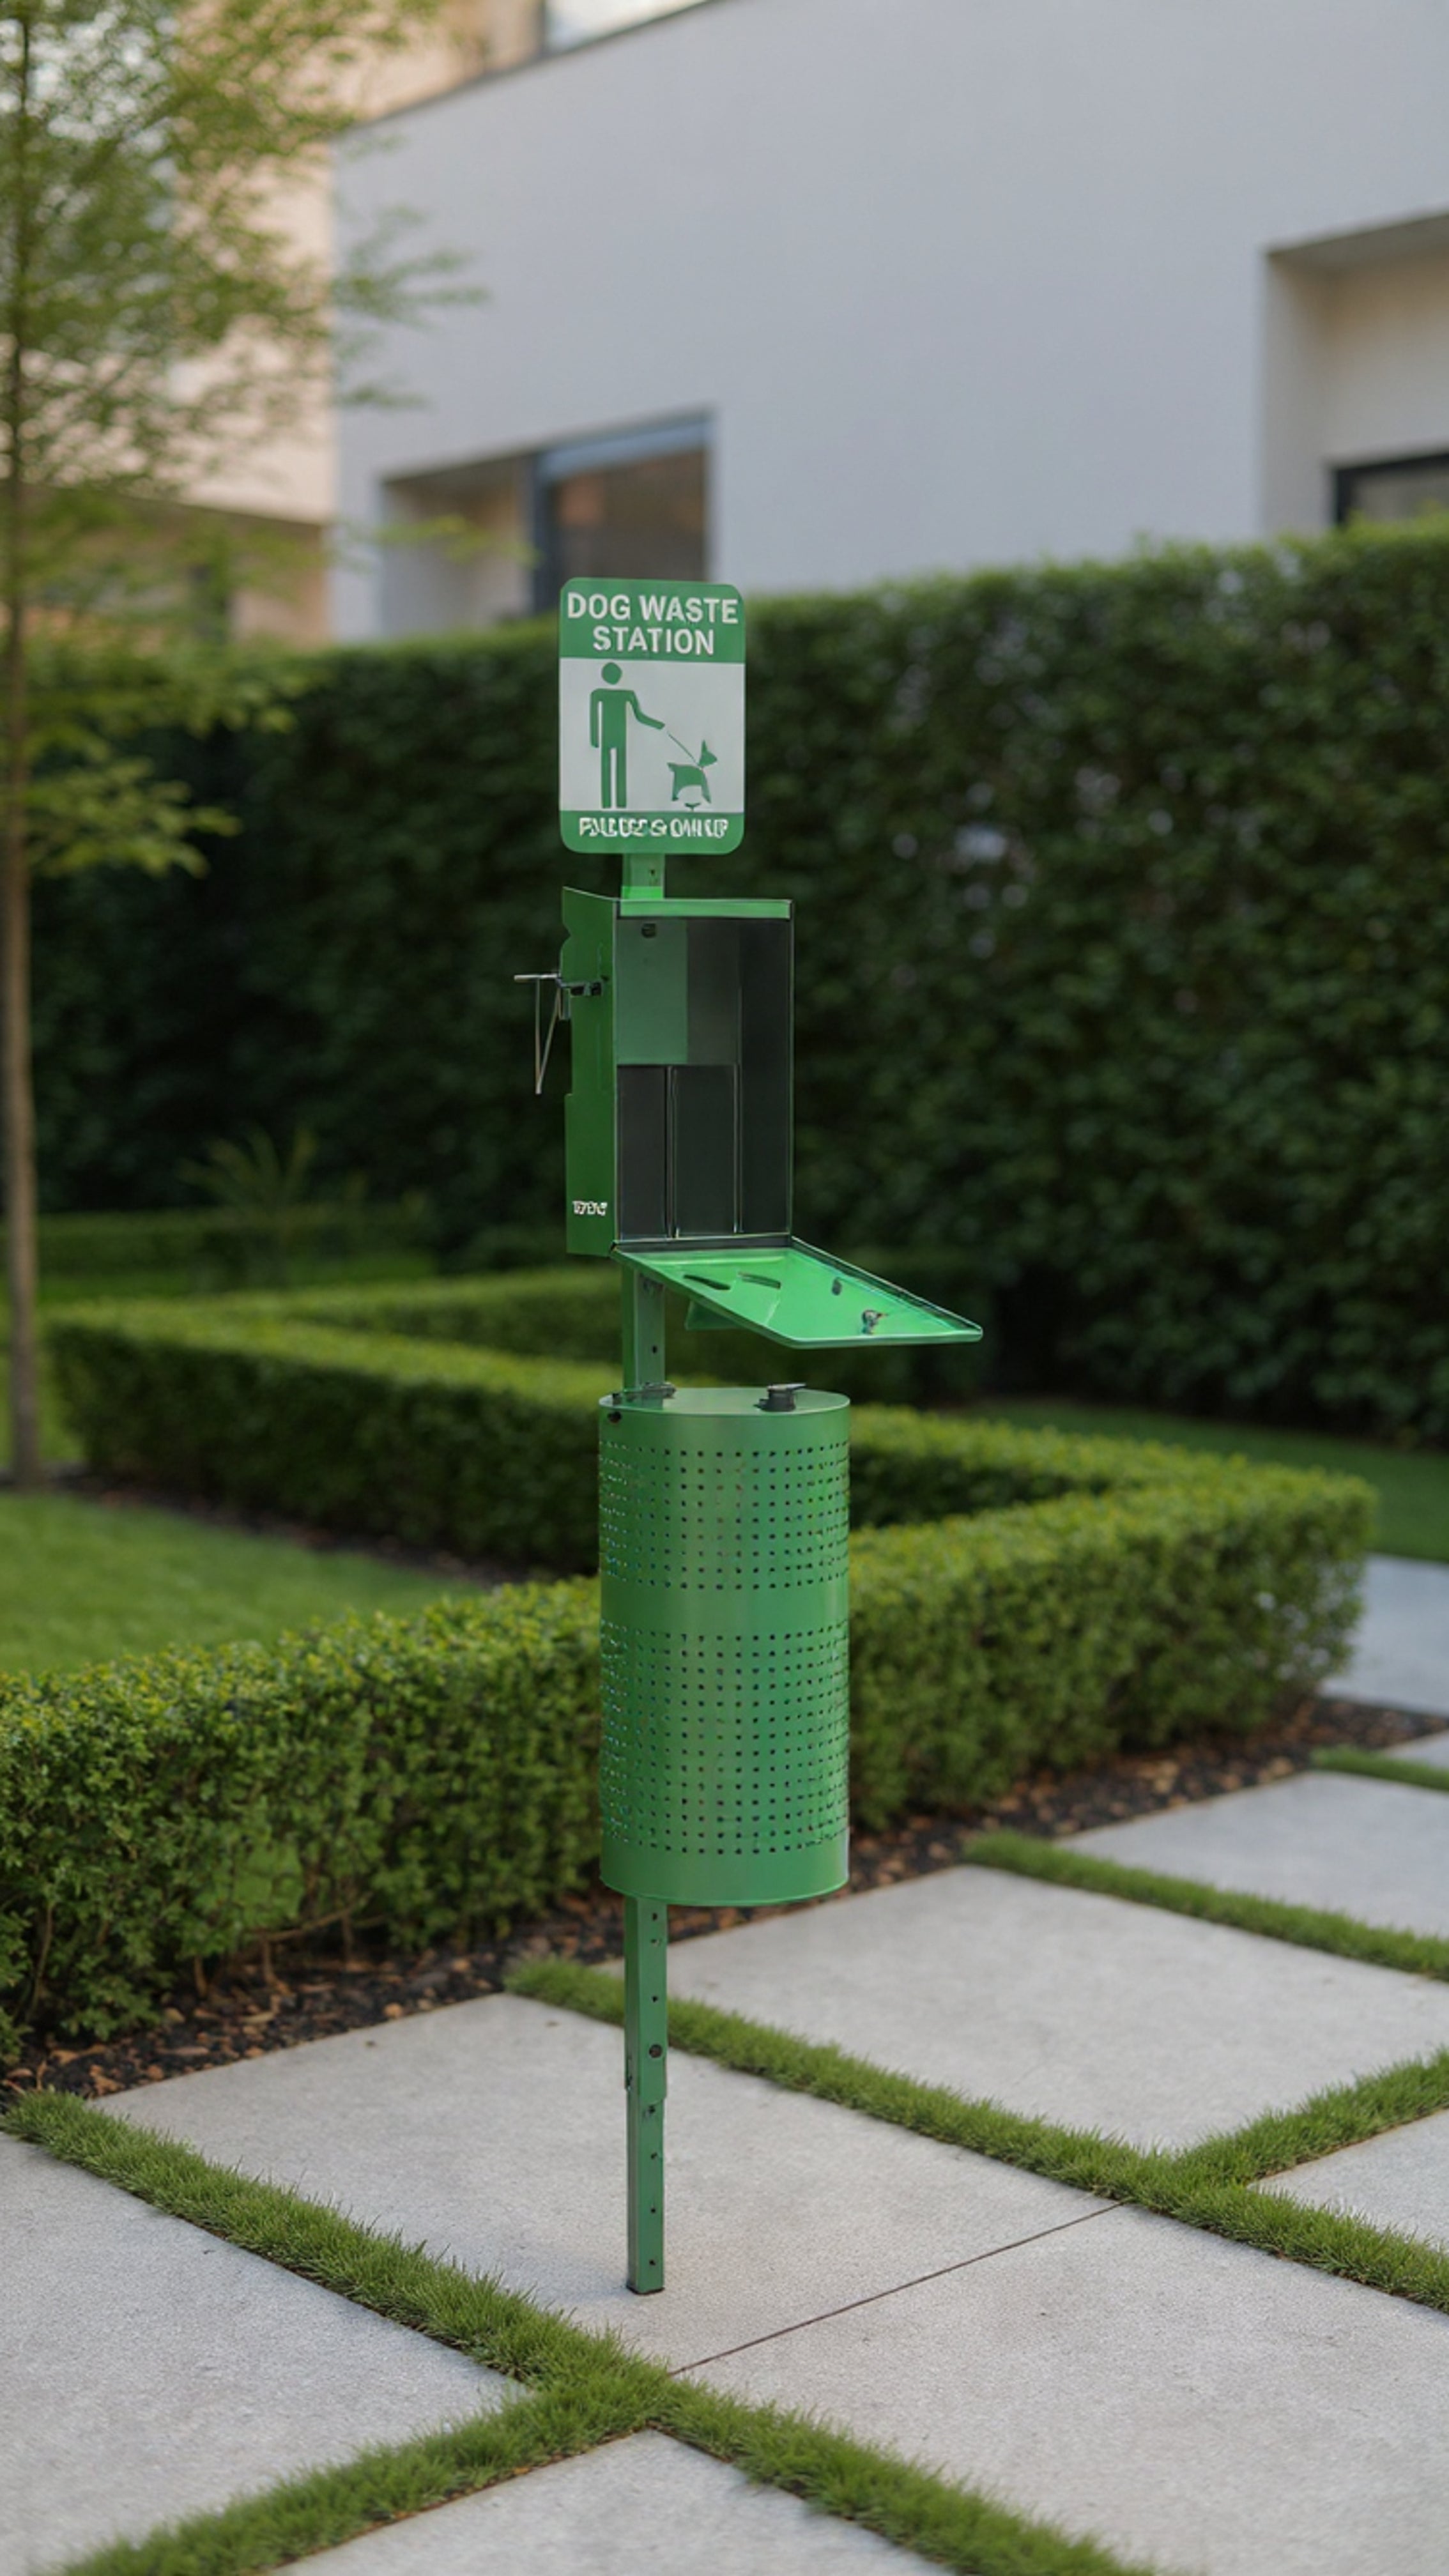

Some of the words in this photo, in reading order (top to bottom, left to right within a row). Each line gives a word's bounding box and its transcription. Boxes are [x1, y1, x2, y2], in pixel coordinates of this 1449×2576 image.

[567, 592, 631, 620] DOG
[639, 595, 738, 624] WASTE
[593, 625, 714, 656] STATION
